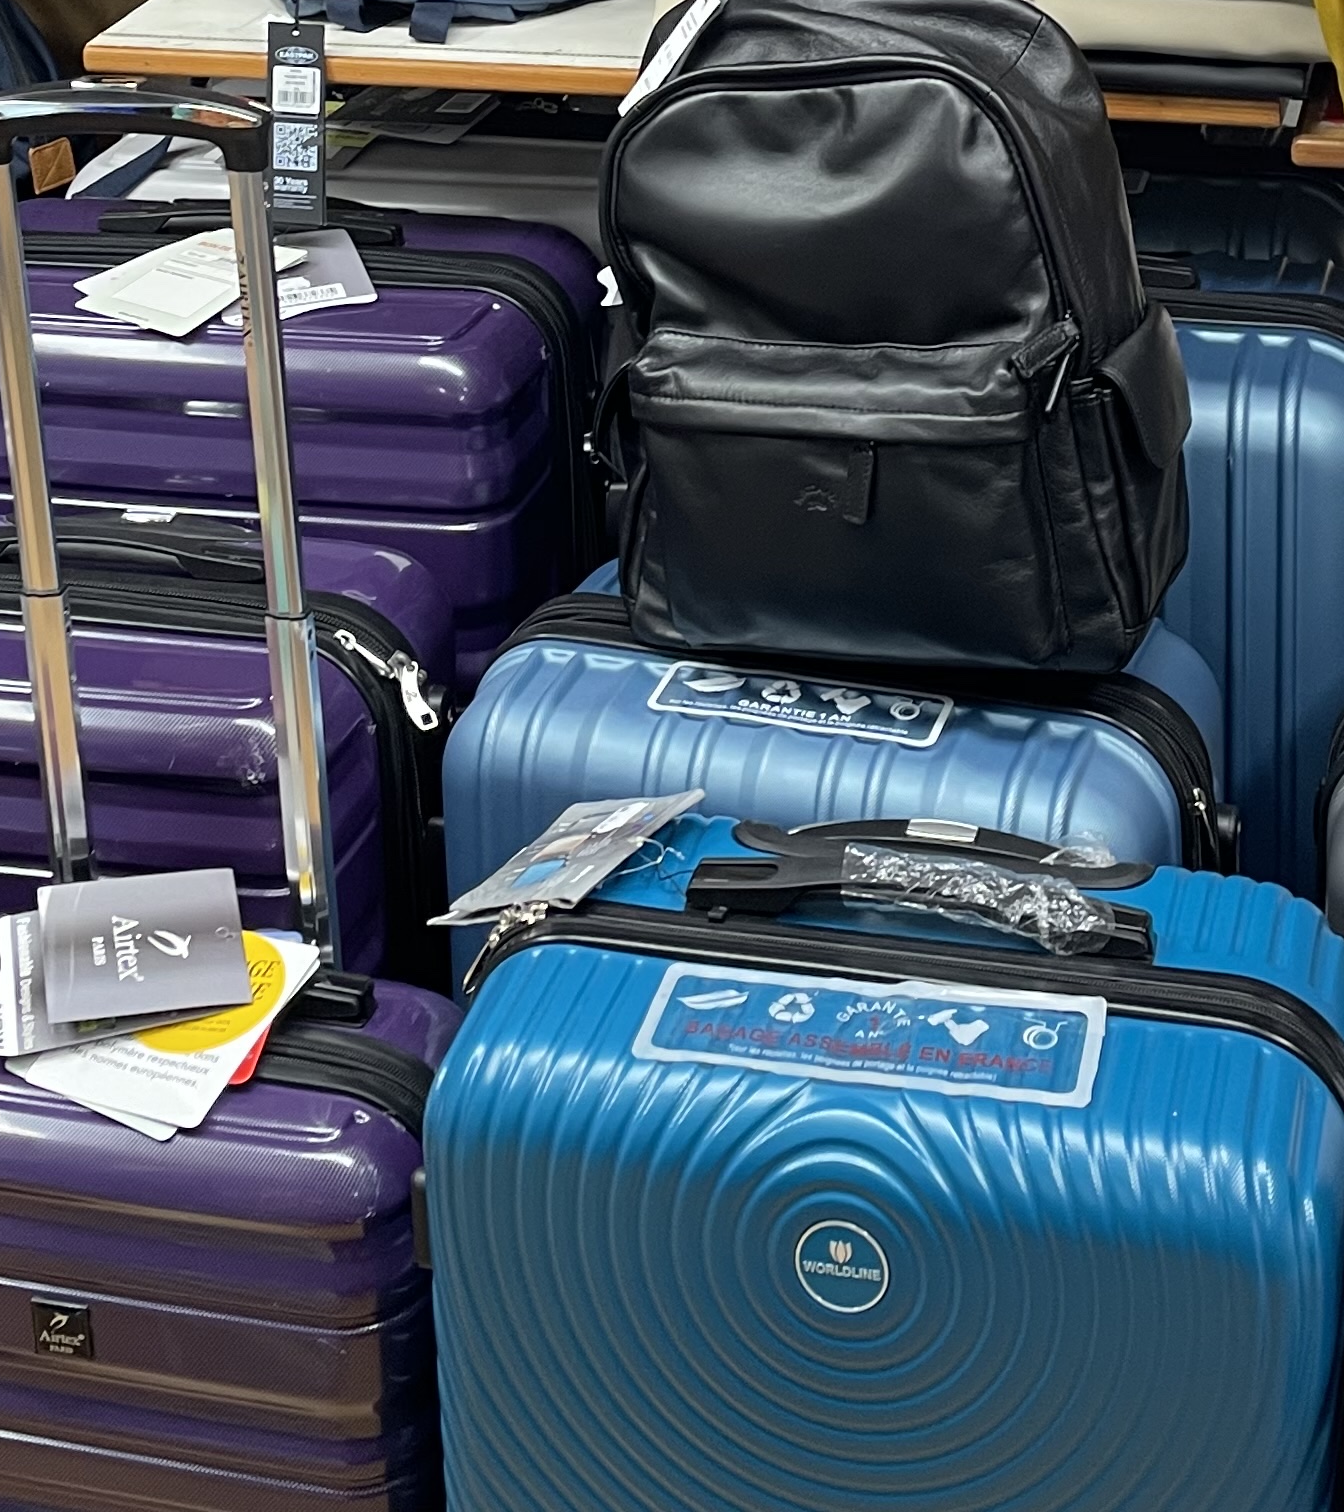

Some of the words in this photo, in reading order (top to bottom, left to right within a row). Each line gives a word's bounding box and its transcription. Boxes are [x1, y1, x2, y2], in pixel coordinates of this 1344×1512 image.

[738, 699, 816, 718] GARANTIE
[828, 714, 852, 722] AN
[91, 936, 107, 967] PARIS
[111, 914, 143, 982] Airtex
[247, 959, 280, 979] GE
[89, 1053, 128, 1072] normes
[146, 1052, 210, 1076] respectueux
[918, 1046, 951, 1063] EN
[802, 1259, 882, 1282] WORLDLINE
[39, 1329, 84, 1346] Airtex
